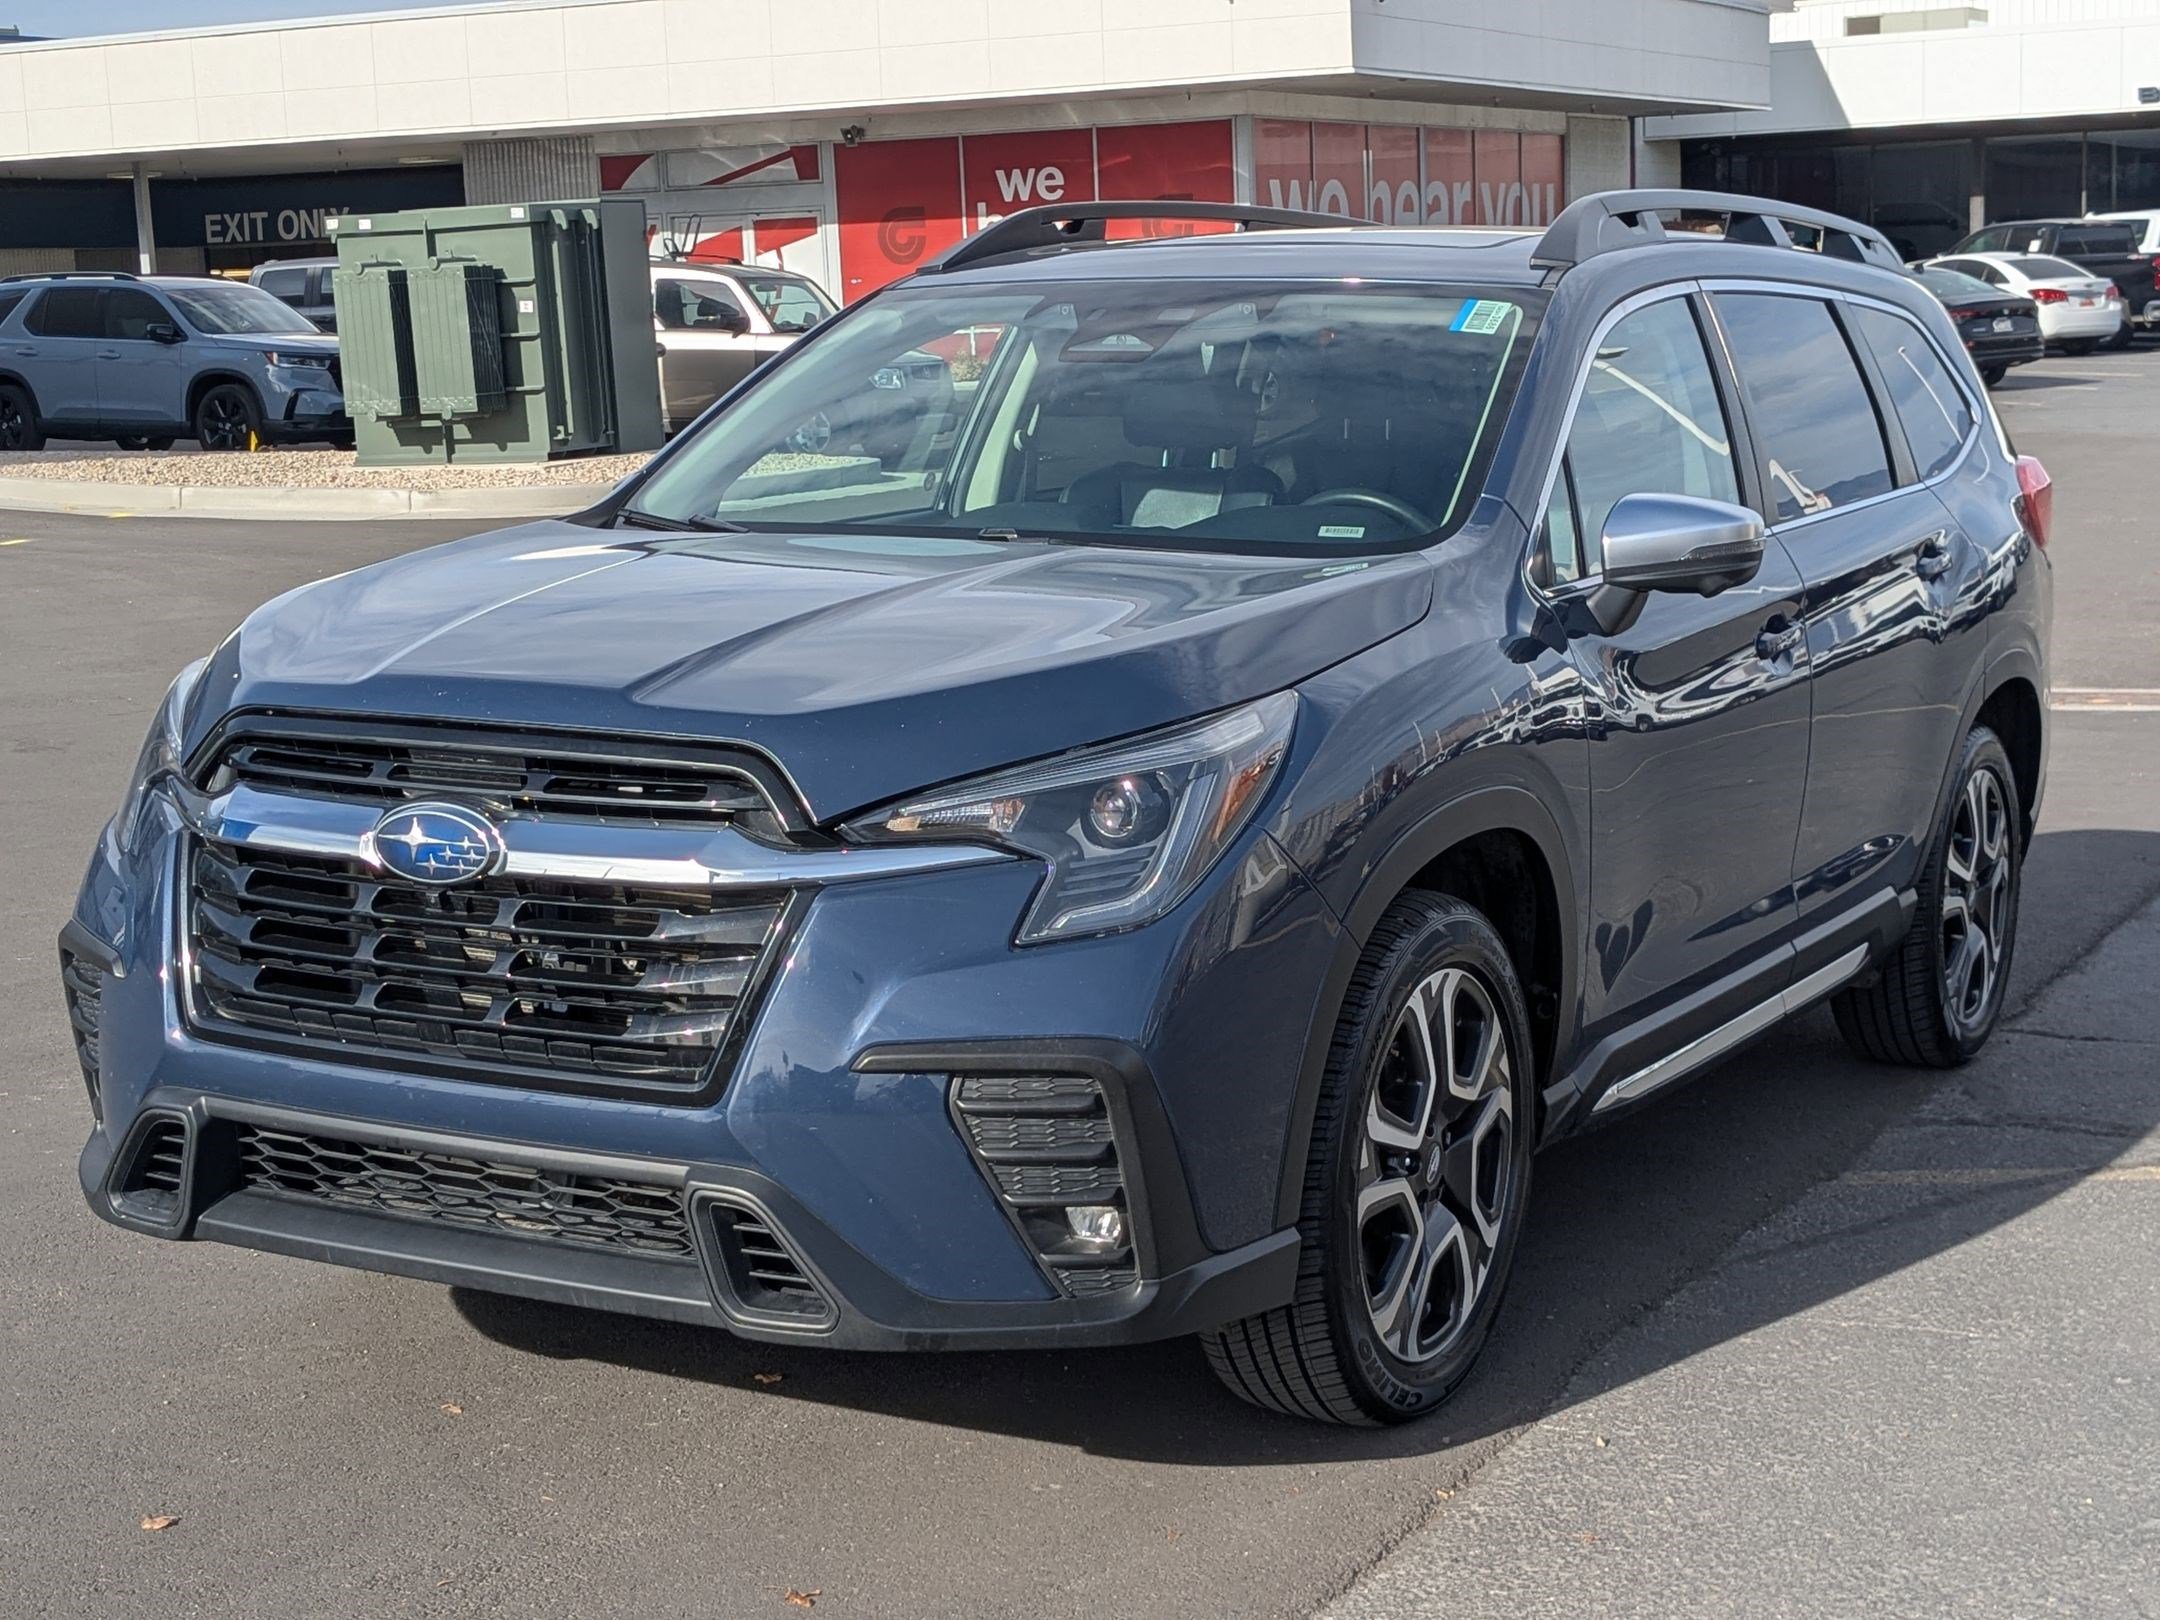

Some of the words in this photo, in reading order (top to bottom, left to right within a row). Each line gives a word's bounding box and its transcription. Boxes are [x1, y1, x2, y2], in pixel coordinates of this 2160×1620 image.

[995, 166, 1065, 202] we
[205, 211, 269, 244] EXIT
[277, 207, 350, 241] ONL
[1357, 1337, 1424, 1408] CELIMO
